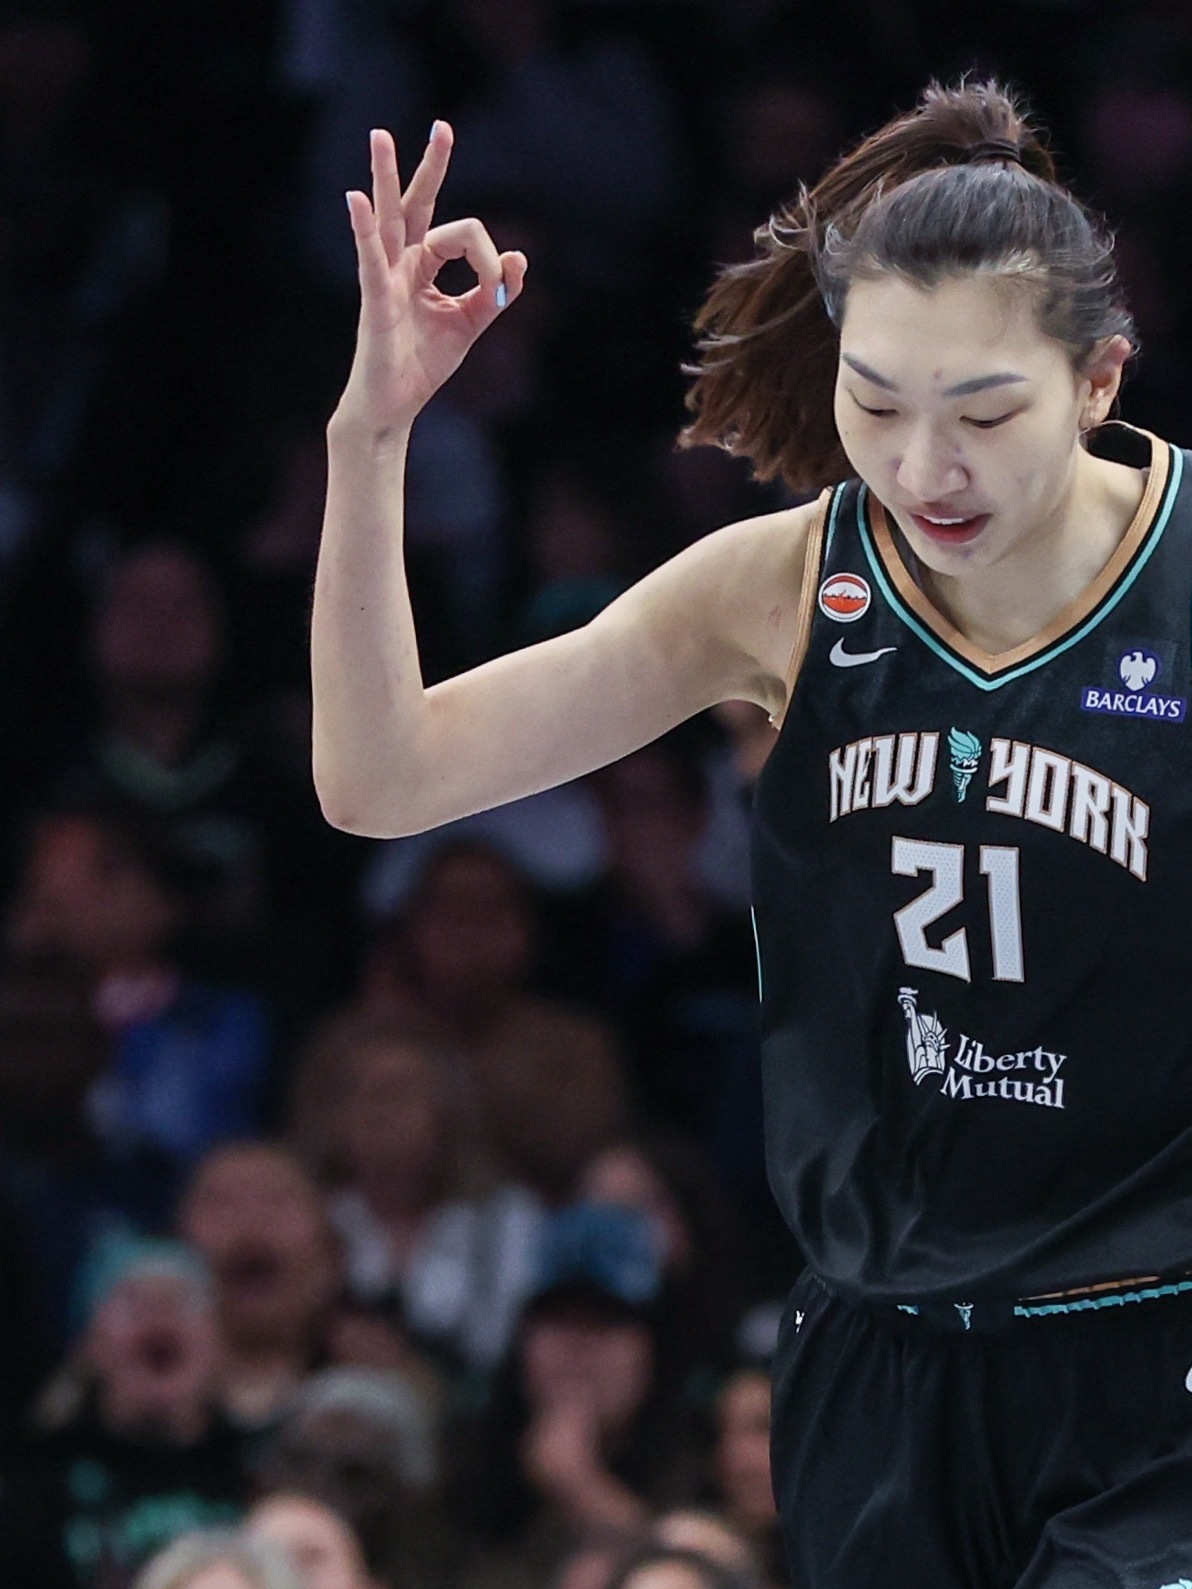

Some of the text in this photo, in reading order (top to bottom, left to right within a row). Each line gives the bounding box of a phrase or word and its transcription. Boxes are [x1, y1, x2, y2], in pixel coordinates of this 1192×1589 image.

[1085, 690, 1181, 718] BARCLAYS
[829, 731, 1150, 882] NEW YORK
[891, 834, 1025, 984] 21
[953, 1033, 1067, 1081] Liberty
[940, 1068, 1065, 1109] Mutual
